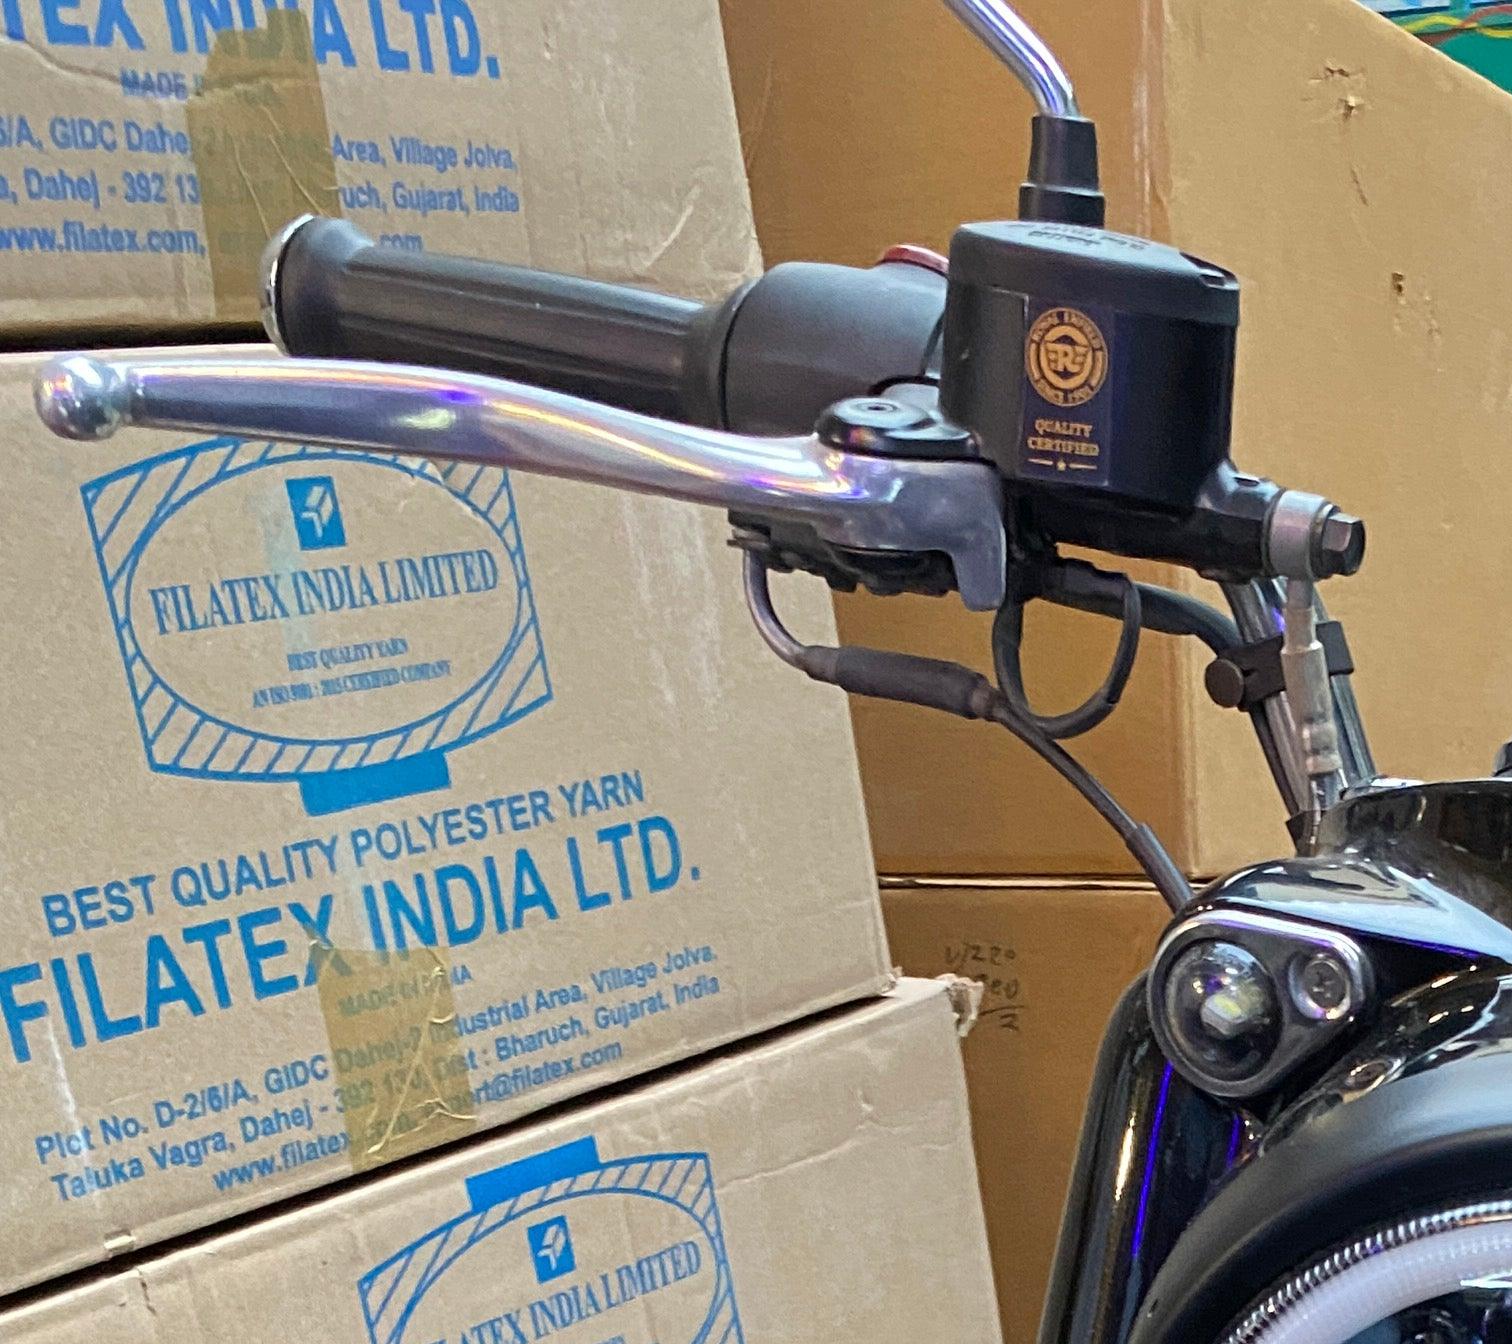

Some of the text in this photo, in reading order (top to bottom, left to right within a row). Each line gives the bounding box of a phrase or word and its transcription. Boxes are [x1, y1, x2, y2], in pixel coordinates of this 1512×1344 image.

[367, 0, 500, 79] LTD.
[24, 167, 100, 210] Dahej
[123, 170, 166, 203] 392
[474, 185, 519, 213] India
[50, 116, 117, 152] GIDC
[124, 120, 192, 155] Dahe
[390, 135, 457, 173] Village
[149, 549, 498, 636] FILATEX INDIA LIMITED
[41, 769, 645, 938] BEST QUALITY POLYESTER YARN
[0, 815, 701, 1064] FILATEX INDIA LTD.
[51, 1156, 145, 1201] Taluka
[240, 1099, 315, 1144] Dahej
[495, 1018, 589, 1061] Bharuch,
[673, 974, 719, 1005] India
[98, 1114, 148, 1146] No.
[264, 1054, 330, 1095] GIDC
[591, 960, 657, 994] Village
[528, 1281, 601, 1340] INDIA
[600, 1240, 701, 1310] LIMITED
